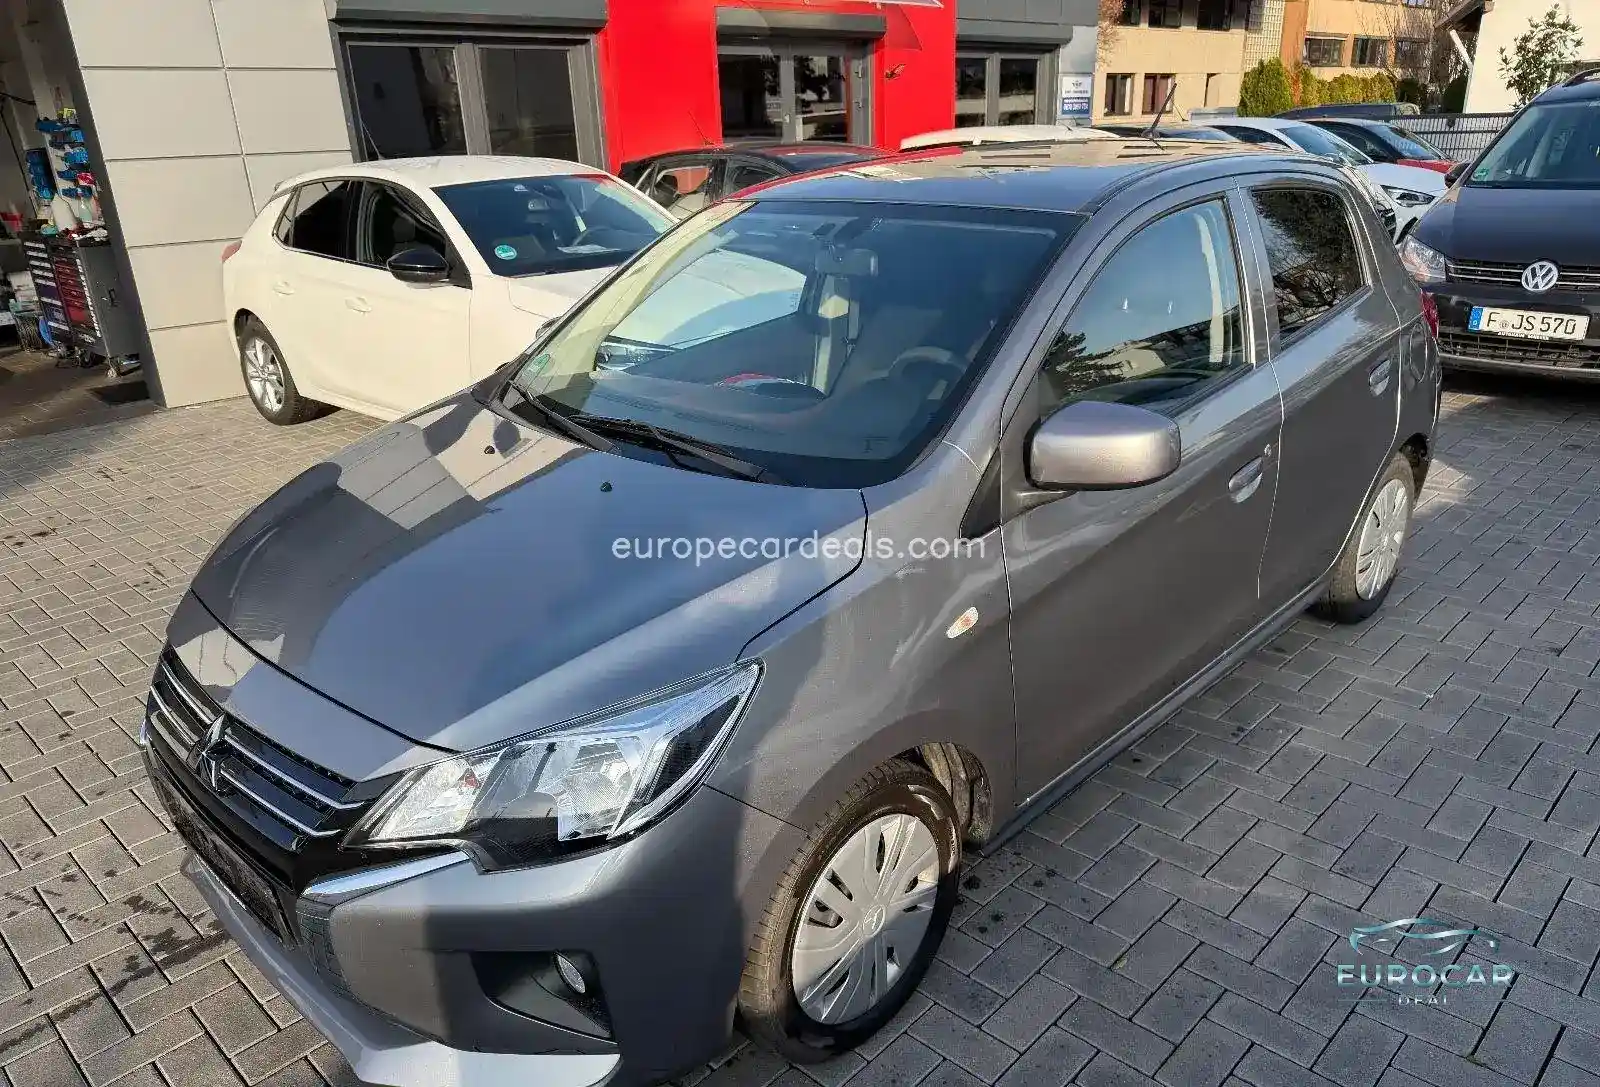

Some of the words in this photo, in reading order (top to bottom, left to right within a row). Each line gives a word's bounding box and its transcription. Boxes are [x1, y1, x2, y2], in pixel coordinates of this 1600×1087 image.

[1522, 261, 1558, 291] VW
[1487, 312, 1500, 327] F
[1511, 314, 1537, 331] JS
[1539, 316, 1577, 335] 570
